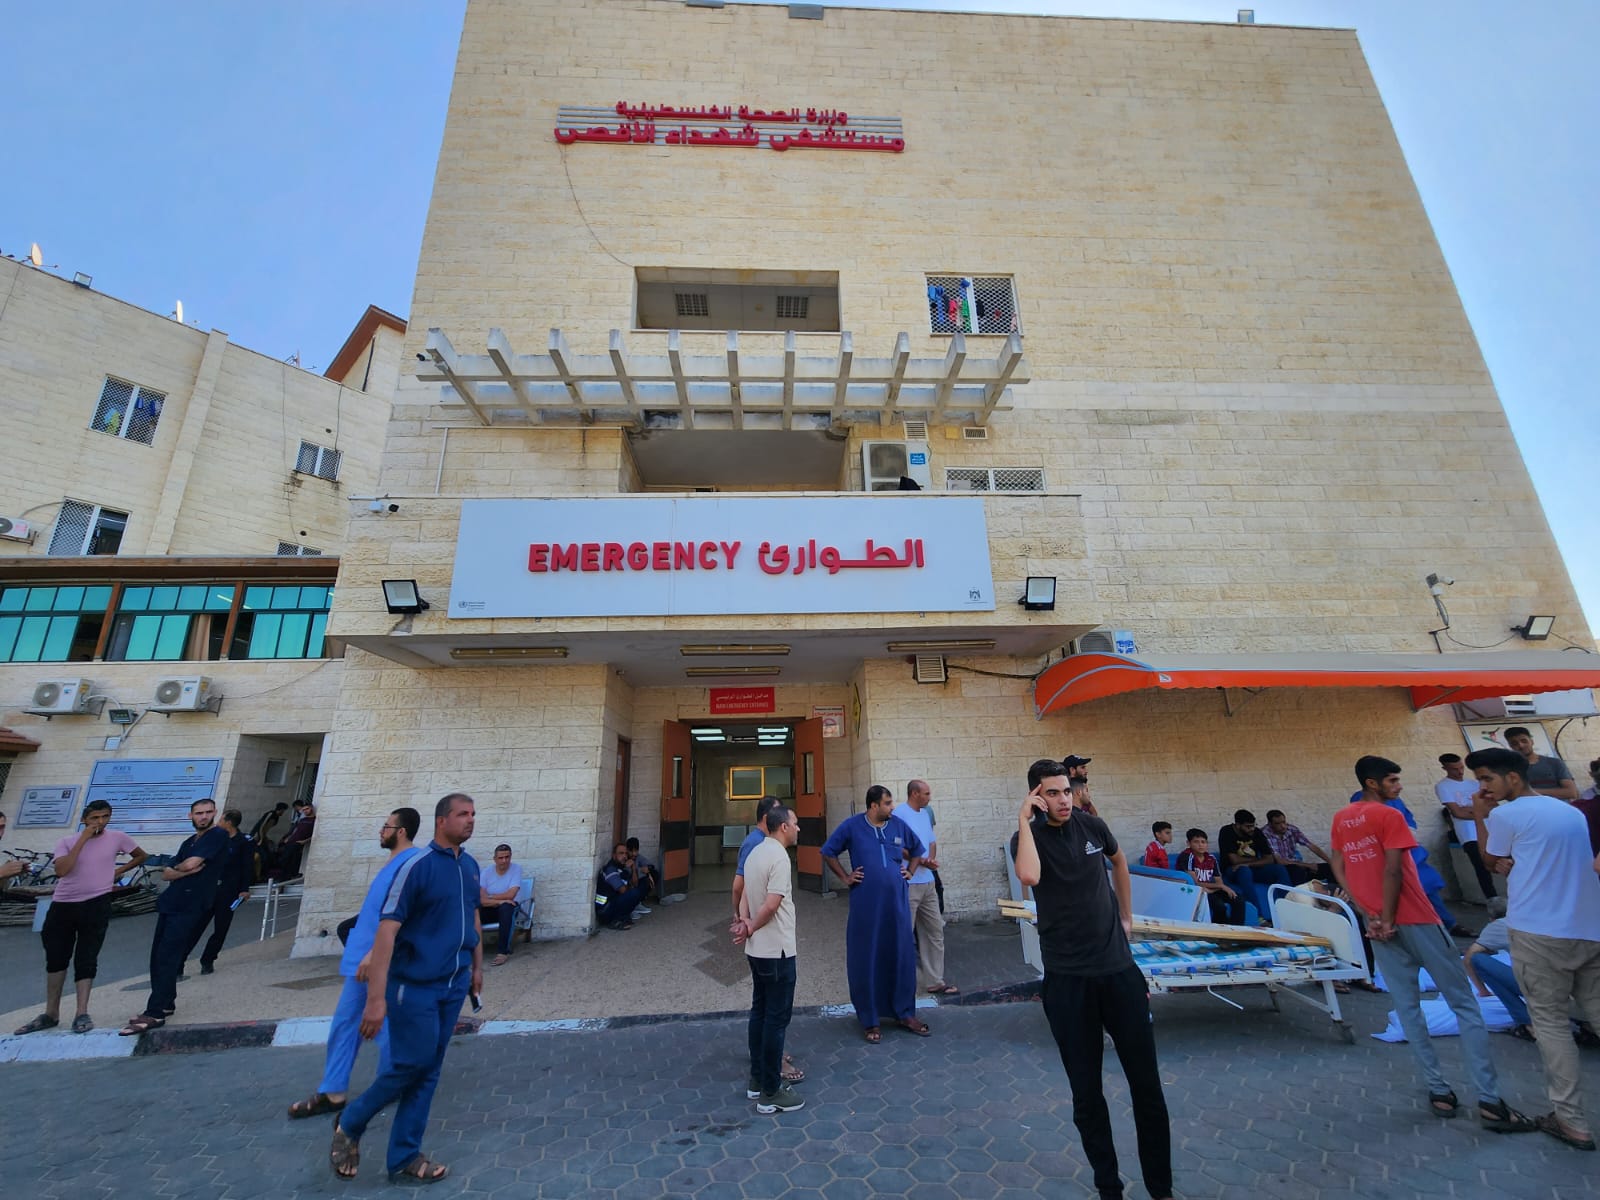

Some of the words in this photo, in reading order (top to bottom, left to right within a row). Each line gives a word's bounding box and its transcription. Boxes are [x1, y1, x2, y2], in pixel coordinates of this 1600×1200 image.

[616, 101, 732, 121] الفلسطينية
[738, 105, 800, 122] الصحة
[806, 108, 847, 126] وزارة
[528, 540, 741, 573] EMERGENCY
[758, 538, 924, 576] الطوارئ
